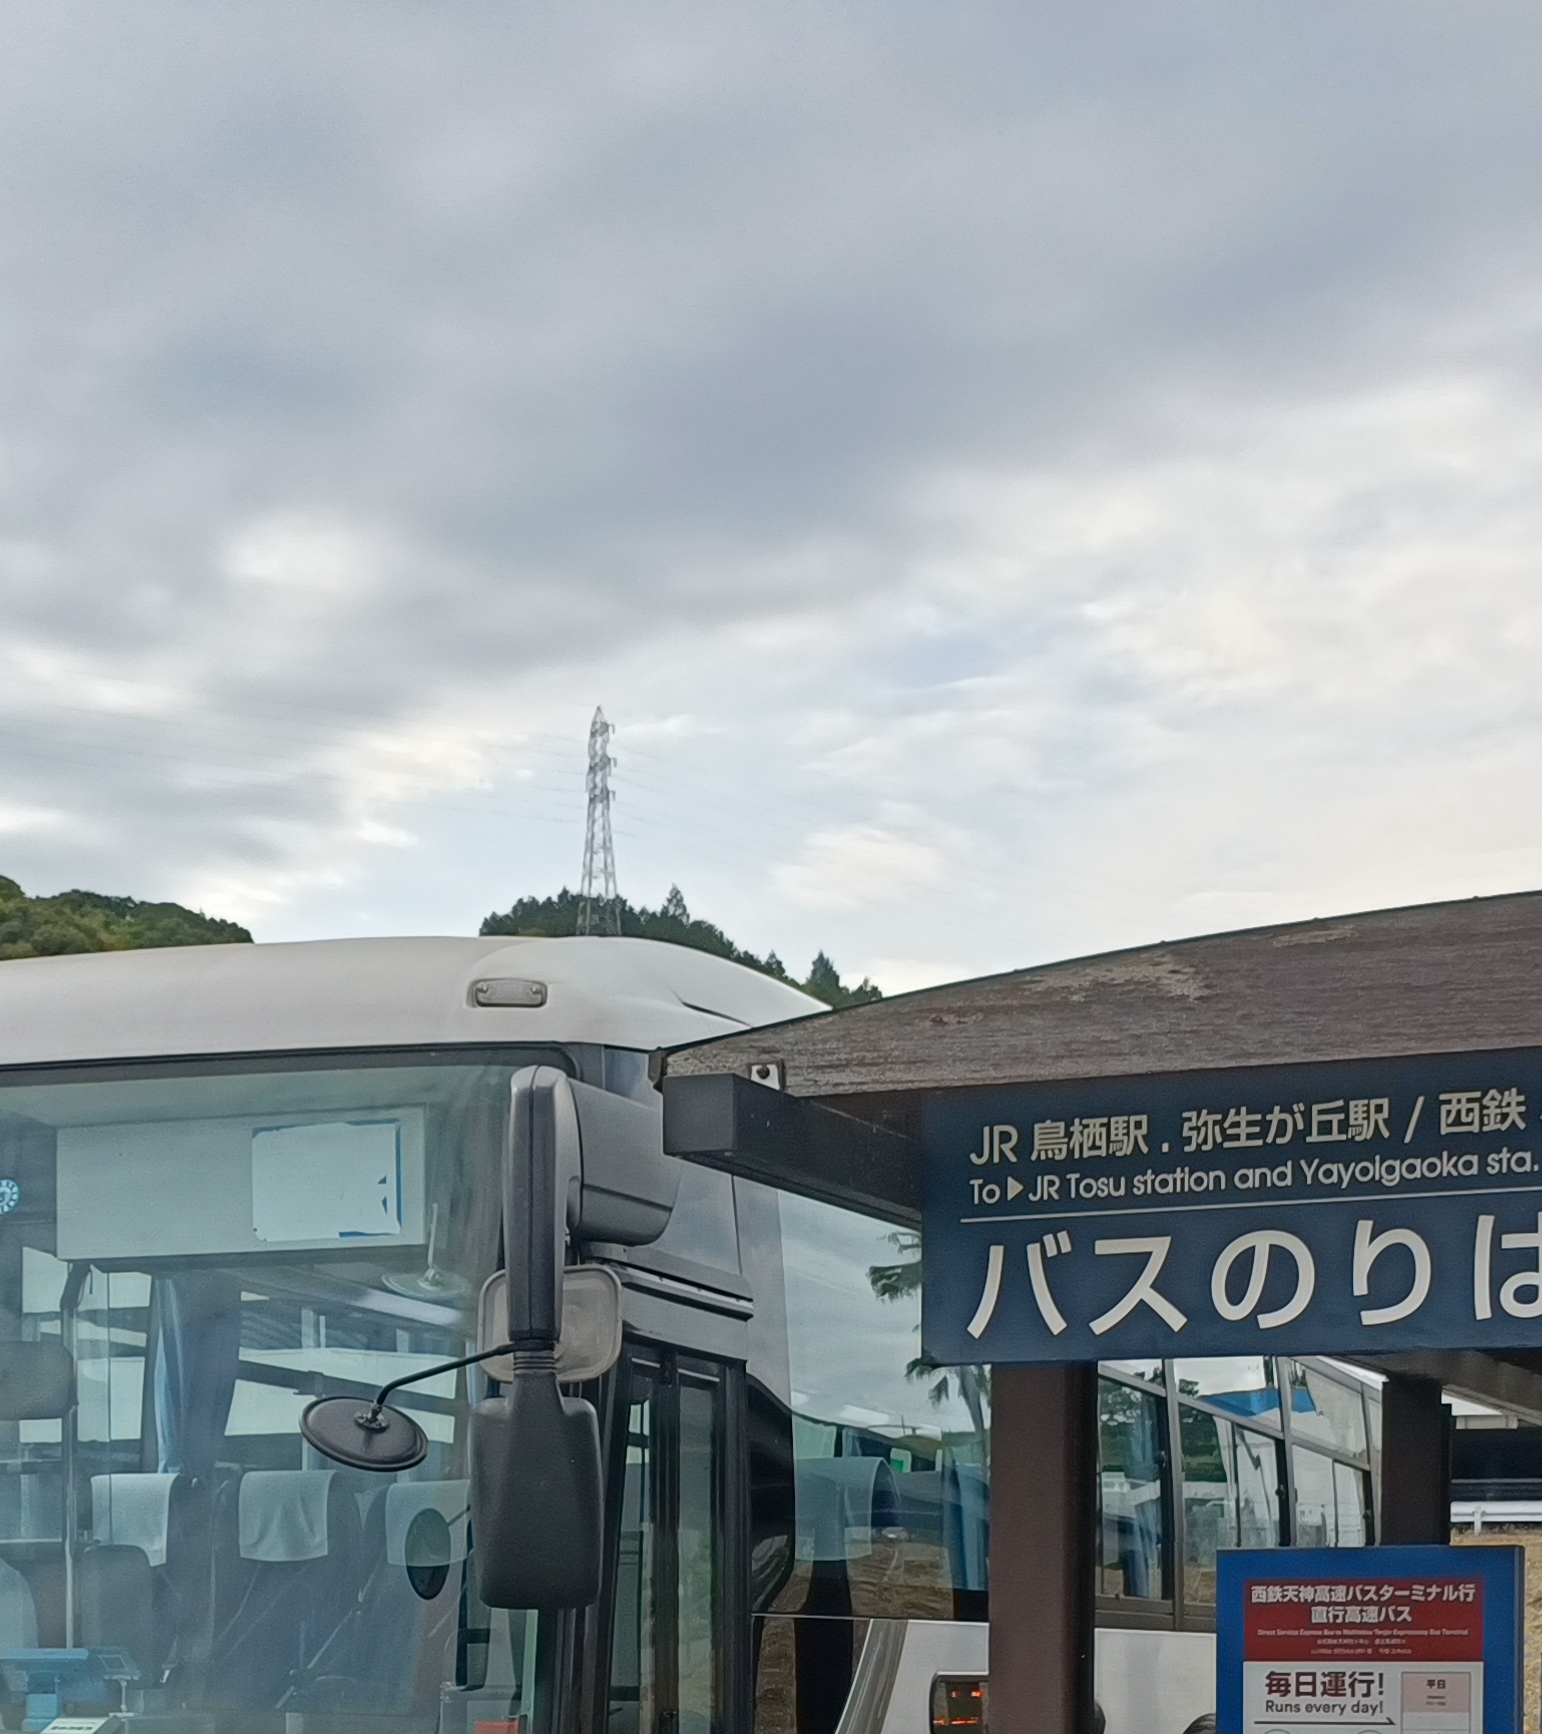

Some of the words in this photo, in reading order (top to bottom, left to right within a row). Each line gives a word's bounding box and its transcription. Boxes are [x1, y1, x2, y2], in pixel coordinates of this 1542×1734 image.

[970, 1125, 1019, 1166] JR
[1182, 1097, 1390, 1154] 弥生が丘駅
[1439, 1087, 1526, 1136] 西鉄
[969, 1177, 1001, 1205] To
[1027, 1175, 1061, 1202] JR
[1066, 1172, 1126, 1199] Tosu
[1132, 1165, 1227, 1197] station
[1234, 1159, 1292, 1190] and
[1300, 1150, 1479, 1191] Yayoigaoka
[1486, 1147, 1541, 1176] sta.
[1250, 1583, 1476, 1604] 西鉄天神高速バスターミナル行
[1310, 1605, 1413, 1624] 直行高速バス
[1265, 1670, 1385, 1698] 毎日運行!
[1265, 1700, 1301, 1714] Runs
[1305, 1702, 1346, 1717] every
[1350, 1700, 1384, 1716] day!
